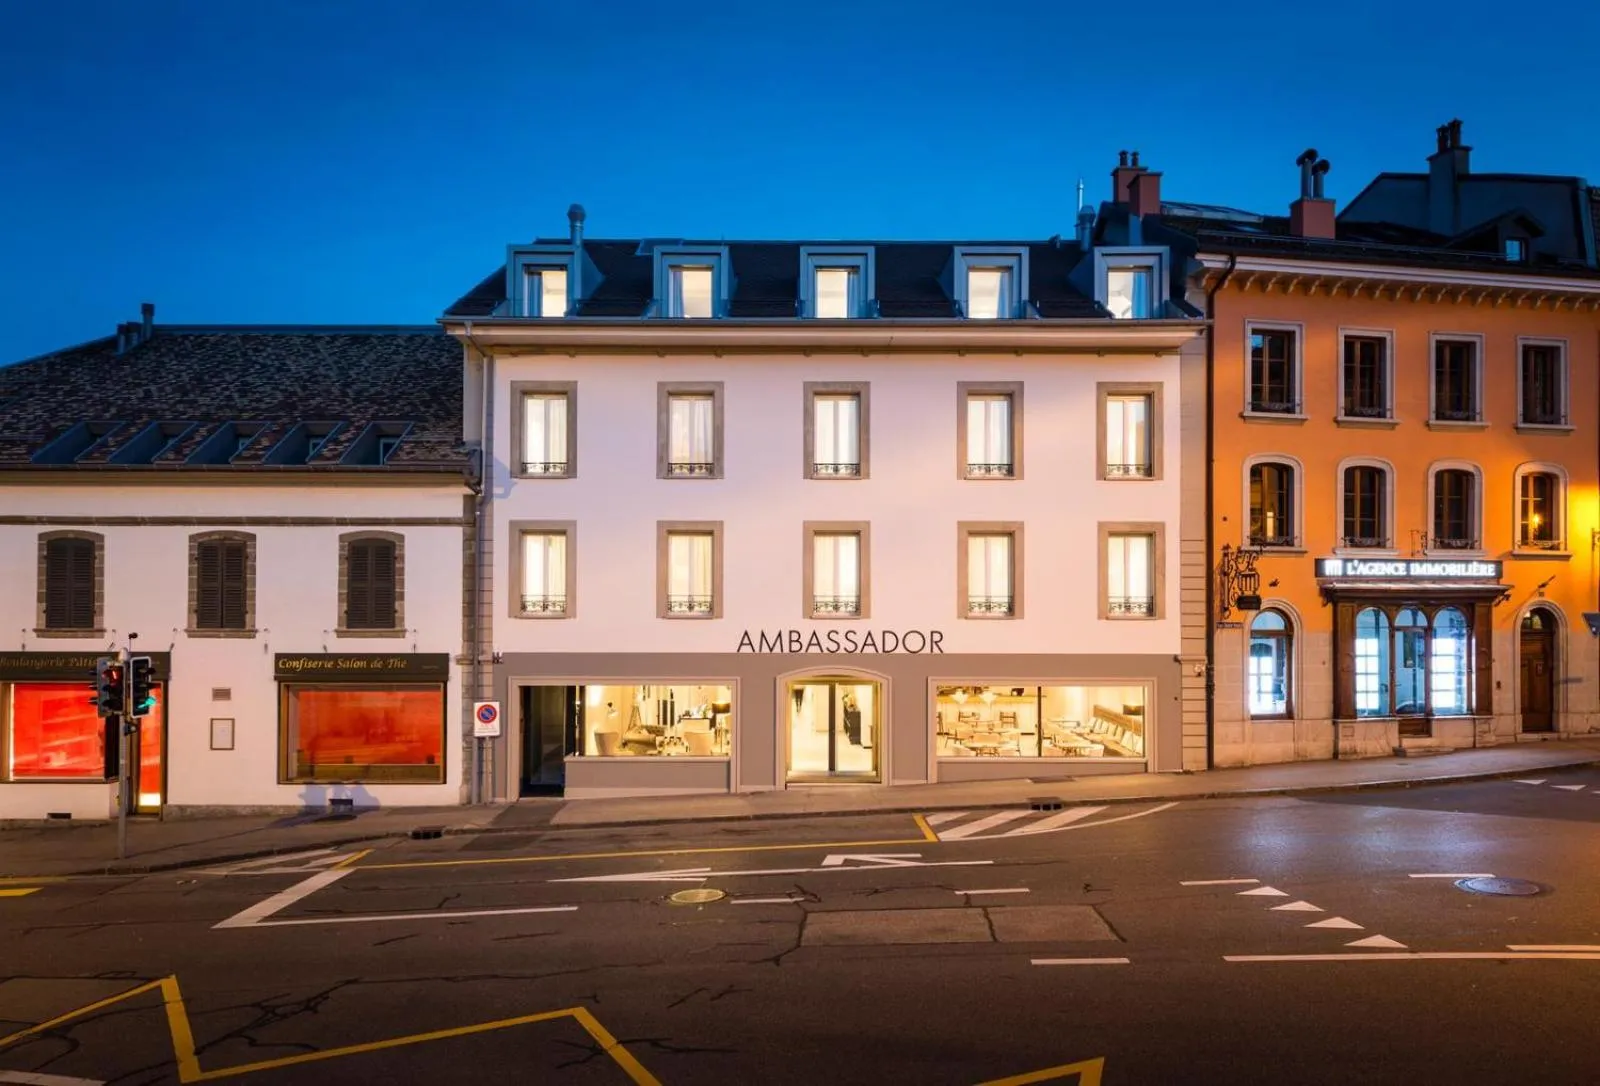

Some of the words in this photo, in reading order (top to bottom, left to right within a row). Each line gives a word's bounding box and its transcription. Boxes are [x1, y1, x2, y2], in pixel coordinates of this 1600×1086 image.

[1410, 561, 1497, 577] IMMOBILIÈRE
[737, 629, 945, 654] AMBASSADOR
[278, 656, 334, 672] Confiserie
[337, 657, 367, 669] Salon
[370, 657, 384, 669] de
